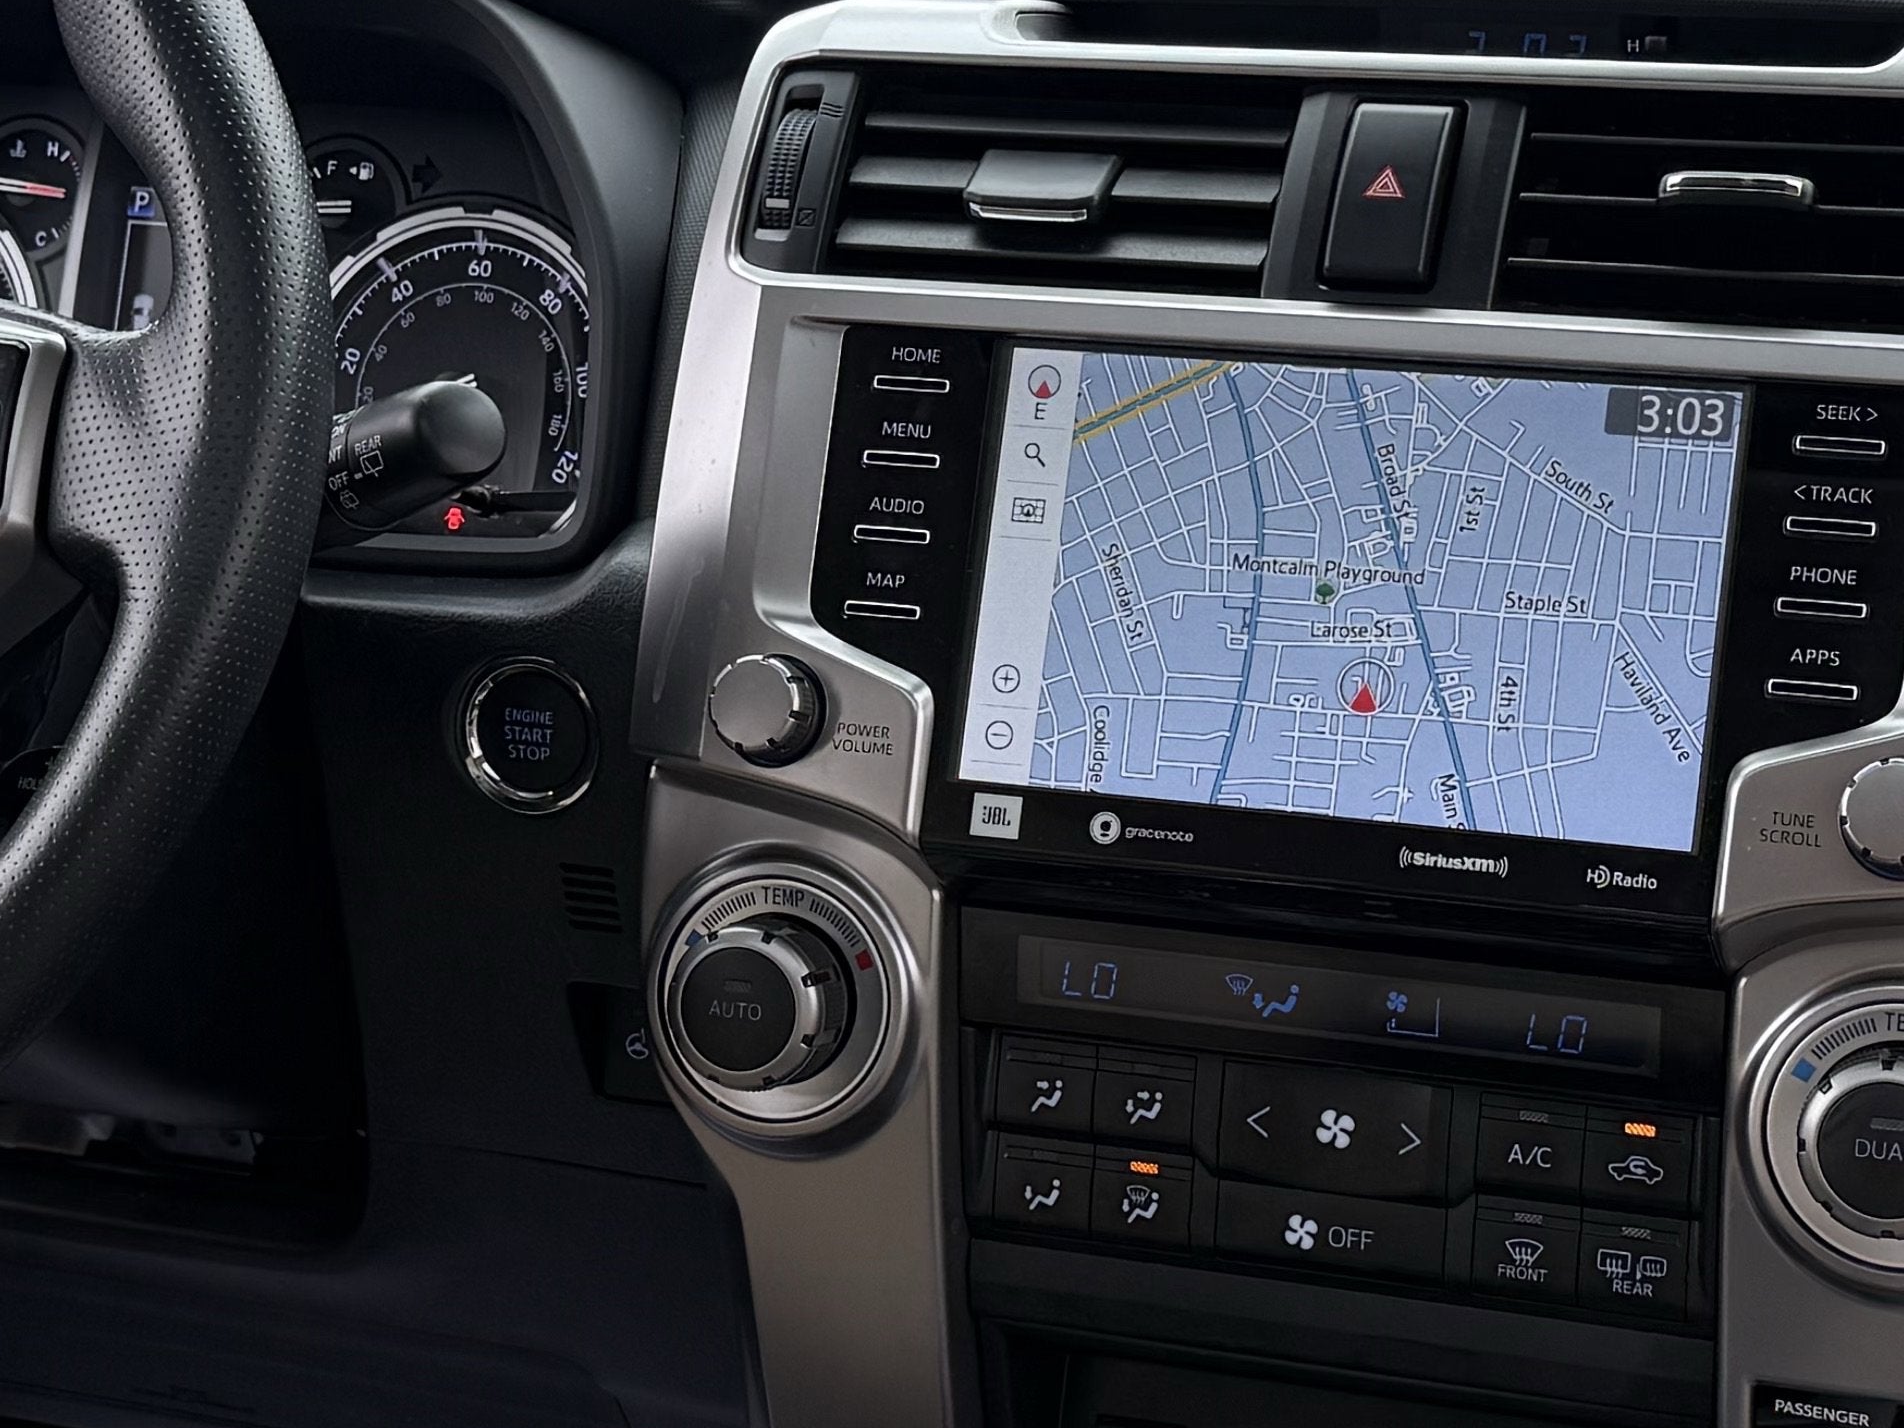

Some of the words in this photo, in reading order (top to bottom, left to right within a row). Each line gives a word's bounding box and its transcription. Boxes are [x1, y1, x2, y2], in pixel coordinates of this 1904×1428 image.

[134, 191, 150, 213] P
[468, 259, 493, 278] 60
[390, 279, 415, 304] 40
[473, 289, 495, 304] 100
[539, 289, 563, 315] 80
[510, 301, 530, 321] 120
[340, 347, 361, 375] 20
[890, 346, 942, 365] HOME
[1033, 401, 1049, 421] E
[1637, 394, 1726, 437] 3:03
[1815, 404, 1862, 422] SEEK
[881, 420, 933, 439] MENU
[354, 434, 382, 457] REAR
[551, 450, 579, 485] 120
[1377, 442, 1406, 498] Broad
[327, 470, 350, 491] OFF
[1544, 458, 1592, 504] South
[1589, 490, 1616, 516] St
[868, 496, 926, 515] AUDIO
[1464, 485, 1486, 506] St
[1808, 485, 1874, 506] TRACK
[1458, 506, 1482, 535] 1st
[1232, 552, 1319, 578] Montcalm
[1323, 559, 1426, 586] Playground
[1789, 565, 1859, 587] PHONE
[866, 572, 906, 590] MAP
[1101, 542, 1135, 620] Sheridan
[1126, 619, 1145, 642] St
[1504, 590, 1563, 617] Staple
[1565, 594, 1588, 615] St
[1310, 620, 1371, 640] Larose
[1371, 621, 1393, 640] St
[1788, 647, 1842, 668] APPS
[1498, 675, 1520, 710] 4th
[504, 707, 554, 725] ENGINE
[1613, 651, 1672, 728] Haviland
[1661, 725, 1691, 765] Ave
[836, 721, 891, 740] POWER
[1496, 712, 1517, 733] St
[503, 725, 554, 744] START
[1090, 704, 1111, 784] Coolidge
[508, 744, 550, 761] STOP
[831, 738, 894, 756] VOLUME
[1437, 773, 1459, 820] Main
[982, 804, 1012, 828] JBL
[1770, 811, 1817, 831] TUNE
[1124, 825, 1195, 843] gracenote
[1758, 827, 1823, 849] SCROLL
[1611, 870, 1658, 890] Radio
[760, 885, 805, 908] TEMP
[708, 999, 763, 1022] AUTO
[1506, 1143, 1554, 1170] A/C
[1327, 1224, 1376, 1253] OFF
[1496, 1263, 1549, 1284] FRONT
[1611, 1278, 1654, 1300] REAR
[1773, 1398, 1871, 1428] PASSENGER
